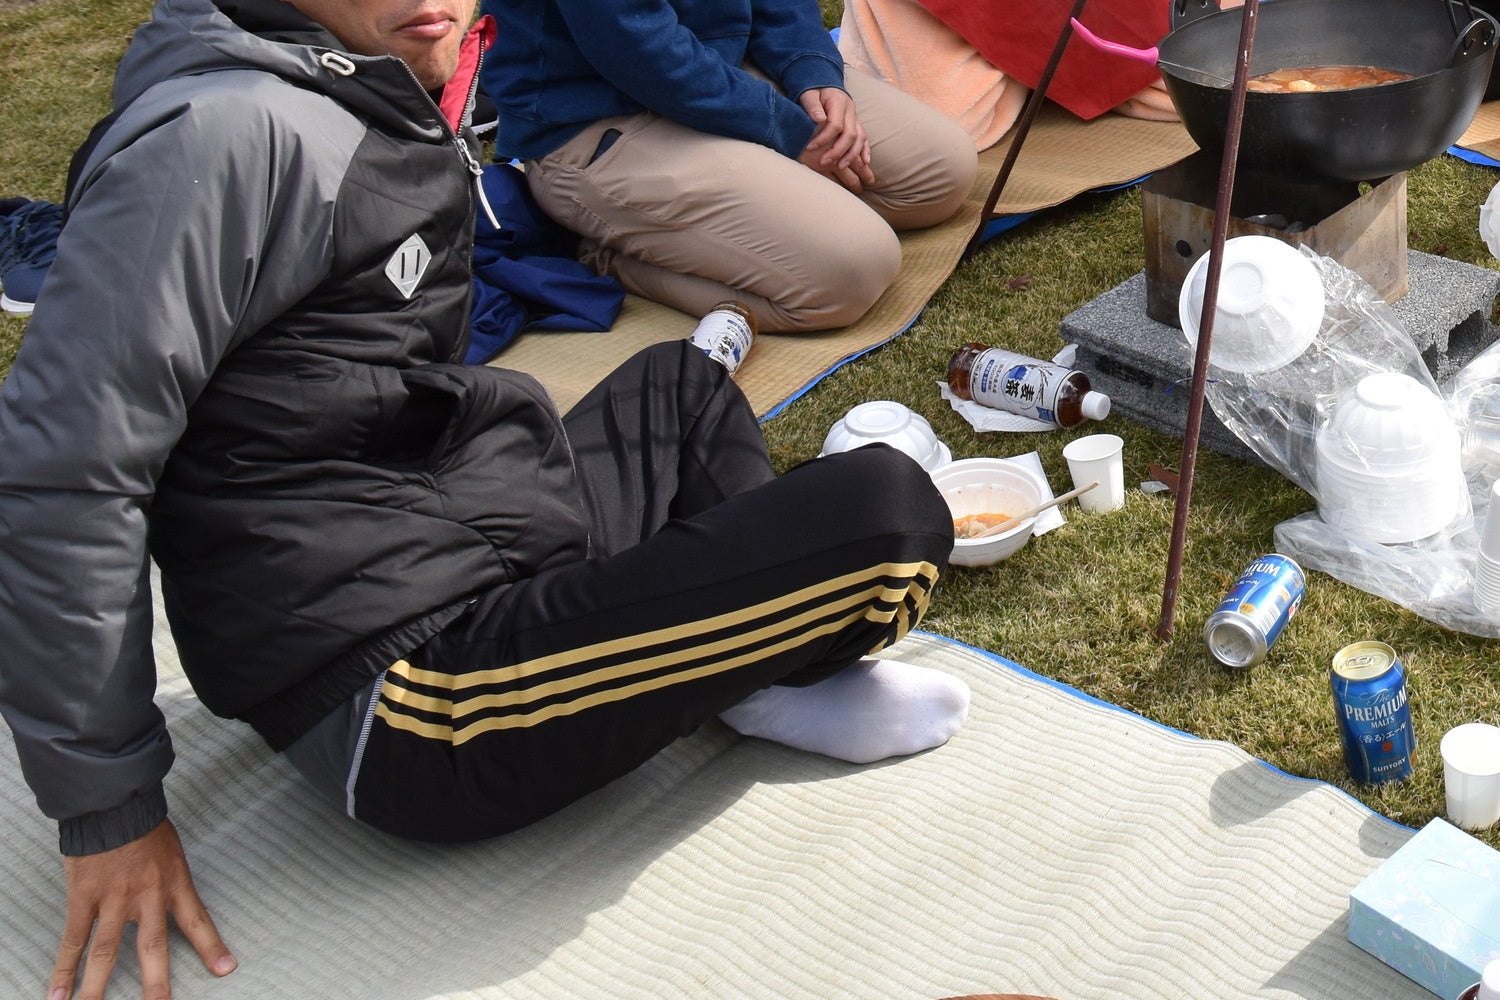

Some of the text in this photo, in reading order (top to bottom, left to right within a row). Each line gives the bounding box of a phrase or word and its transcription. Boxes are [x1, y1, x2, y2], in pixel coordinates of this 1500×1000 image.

[1005, 378, 1035, 401] 麦茶
[1344, 684, 1408, 722] PREMIUM
[1372, 756, 1407, 773] SUNTORY
